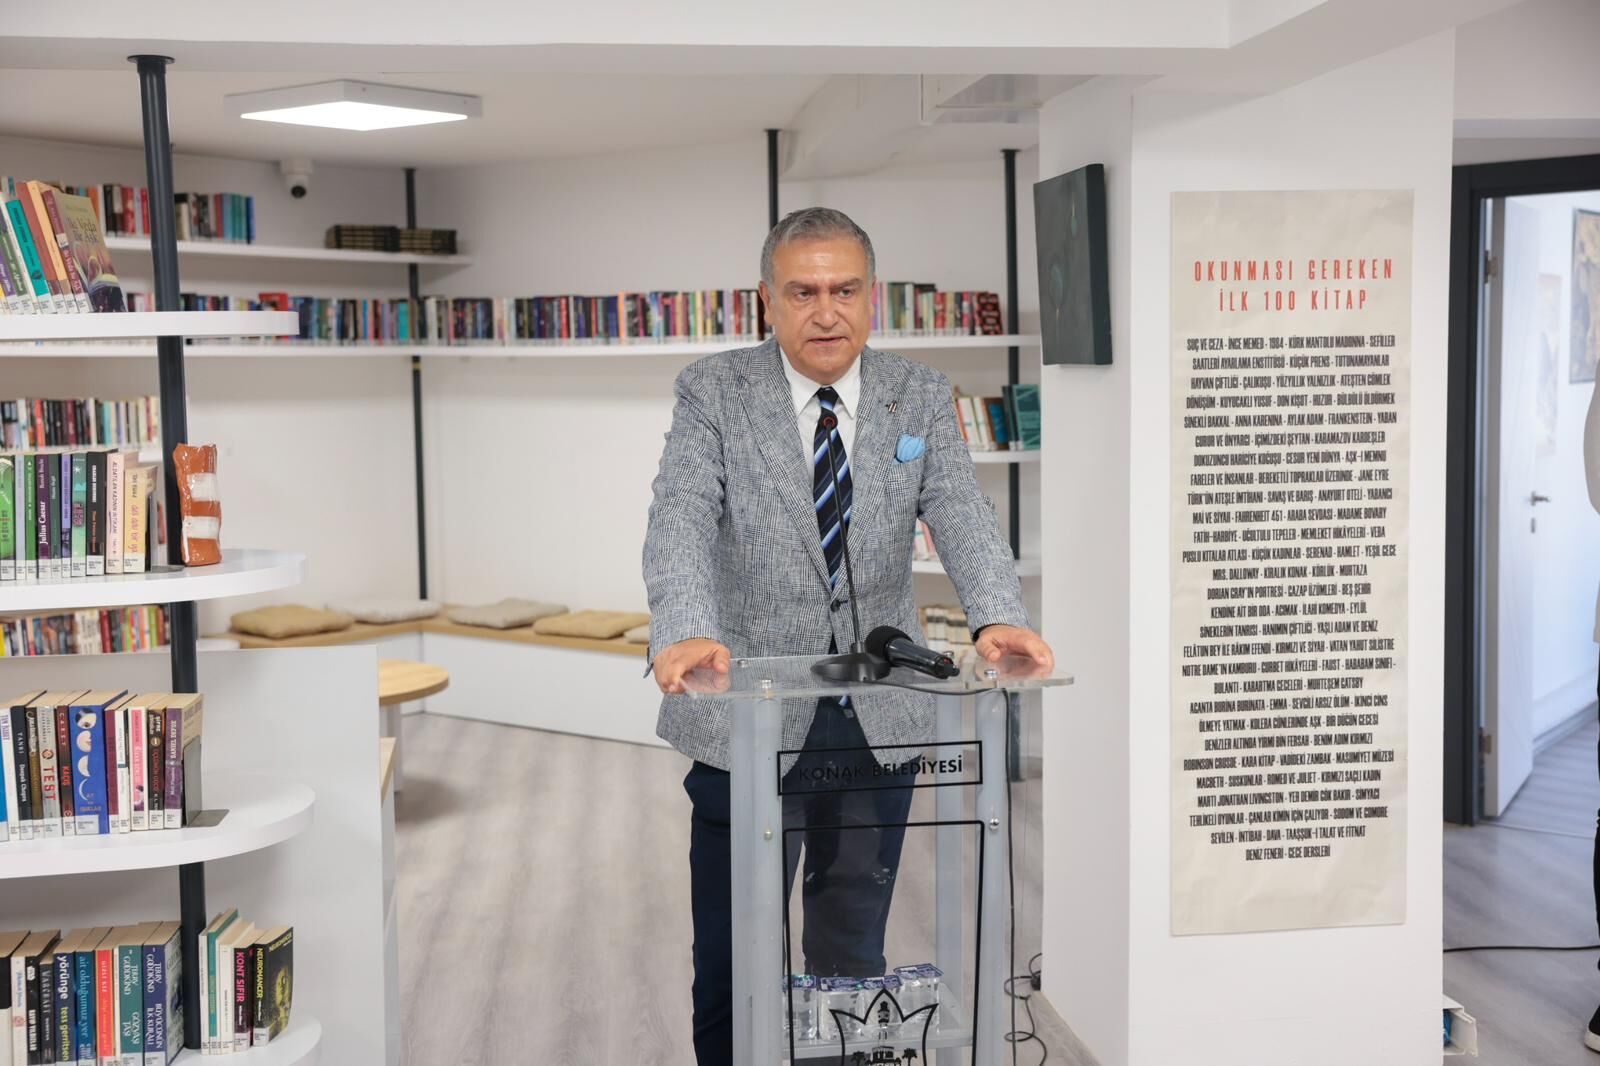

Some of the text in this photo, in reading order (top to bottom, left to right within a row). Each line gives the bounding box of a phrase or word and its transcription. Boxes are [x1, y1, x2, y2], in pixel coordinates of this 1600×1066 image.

[1194, 259, 1392, 281] OKUNMASI GEREKEN
[1219, 286, 1368, 311] İLK 100 KİTAP
[1186, 338, 1199, 352] SUÇ
[1200, 338, 1207, 350] VE
[1208, 337, 1223, 350] CEZA
[1242, 337, 1264, 349] MEMED
[1269, 336, 1283, 349] 1984
[1305, 335, 1334, 348] MANTOLU
[1334, 335, 1364, 348] MADONNA
[1310, 355, 1330, 368] PRENS
[1190, 373, 1366, 389] HAYVAN ATEŞTEN
[1253, 394, 1271, 407] YUSUF
[1207, 415, 1229, 428] BAKKAL
[1234, 414, 1251, 427] ANNA
[1252, 413, 1282, 426] KARENINA
[1287, 413, 1305, 426] AYLAK
[1306, 412, 1323, 425] ADAM
[1377, 411, 1397, 423] YABAN
[1287, 432, 1310, 447] ŞEYTAN
[1285, 451, 1305, 464] CESUR
[1190, 473, 1214, 486] FARELER
[1358, 468, 1372, 481] JANE
[1374, 468, 1388, 481] EYRE
[1214, 491, 1234, 506] ATEŞLE
[1267, 490, 1286, 504] SAVAŞ
[1287, 490, 1294, 502] VE
[1295, 489, 1313, 504] BARIŞ
[1318, 488, 1344, 501] ANAYURT
[1367, 487, 1392, 500] YABANCI
[1205, 511, 1211, 524] VE
[1271, 509, 1282, 521] 451
[1287, 508, 1306, 521] ARABA
[1337, 507, 1362, 520] MADAME
[1363, 506, 1386, 519] BOVARY
[39, 525, 48, 545] Julius
[1272, 525, 1385, 541] TEPELER MEMLEKET VEBA
[1182, 550, 1201, 562] PUSLU
[1202, 549, 1226, 562] KITALAR
[1227, 548, 1247, 561] ATLASI
[1305, 545, 1332, 558] SERENAD
[1336, 544, 1359, 558] HAMLET
[1381, 544, 1395, 556] GECE
[1212, 565, 1307, 581] MRS. DALLOWAY KONAK
[1287, 584, 1307, 597] GAZAP
[1275, 603, 1297, 616] ACIMAK
[1317, 621, 1333, 635] YAŞLI
[1334, 620, 1351, 633] ADAM
[1352, 620, 1359, 632] VE
[1209, 644, 1220, 656] BEY
[1329, 639, 1348, 652] VATAN
[1182, 658, 1339, 676] NOTRE FAUST
[1340, 676, 1362, 689] GATSBY
[1190, 701, 1212, 713] AGANTA
[1269, 697, 1287, 710] EMMA
[1222, 718, 1245, 730] YATMAK
[1250, 717, 1271, 730] KOLERA
[1309, 715, 1321, 729] AŞK
[801, 755, 962, 781] KONAK BELEDİYESİ
[1241, 755, 1257, 768] KARA
[1307, 752, 1331, 765] ZAMBAK
[43, 766, 56, 800] TEST
[1196, 775, 1224, 788] MACBETH
[1197, 794, 1216, 807] MARTI
[1288, 790, 1299, 803] YER
[1248, 810, 1271, 825] ÇANLAR
[1266, 828, 1280, 841] DAVA
[1319, 826, 1335, 838] TALAT
[1337, 825, 1344, 838] VE
[1288, 846, 1301, 858] GECE
[80, 956, 90, 968] ait
[58, 956, 69, 999] yörünge
[130, 965, 138, 985] TERRY
[154, 963, 162, 983] TERRY
[78, 970, 91, 1020] olduğumuz
[60, 1007, 70, 1060] tess gerritsen
[79, 1021, 89, 1037] yer
